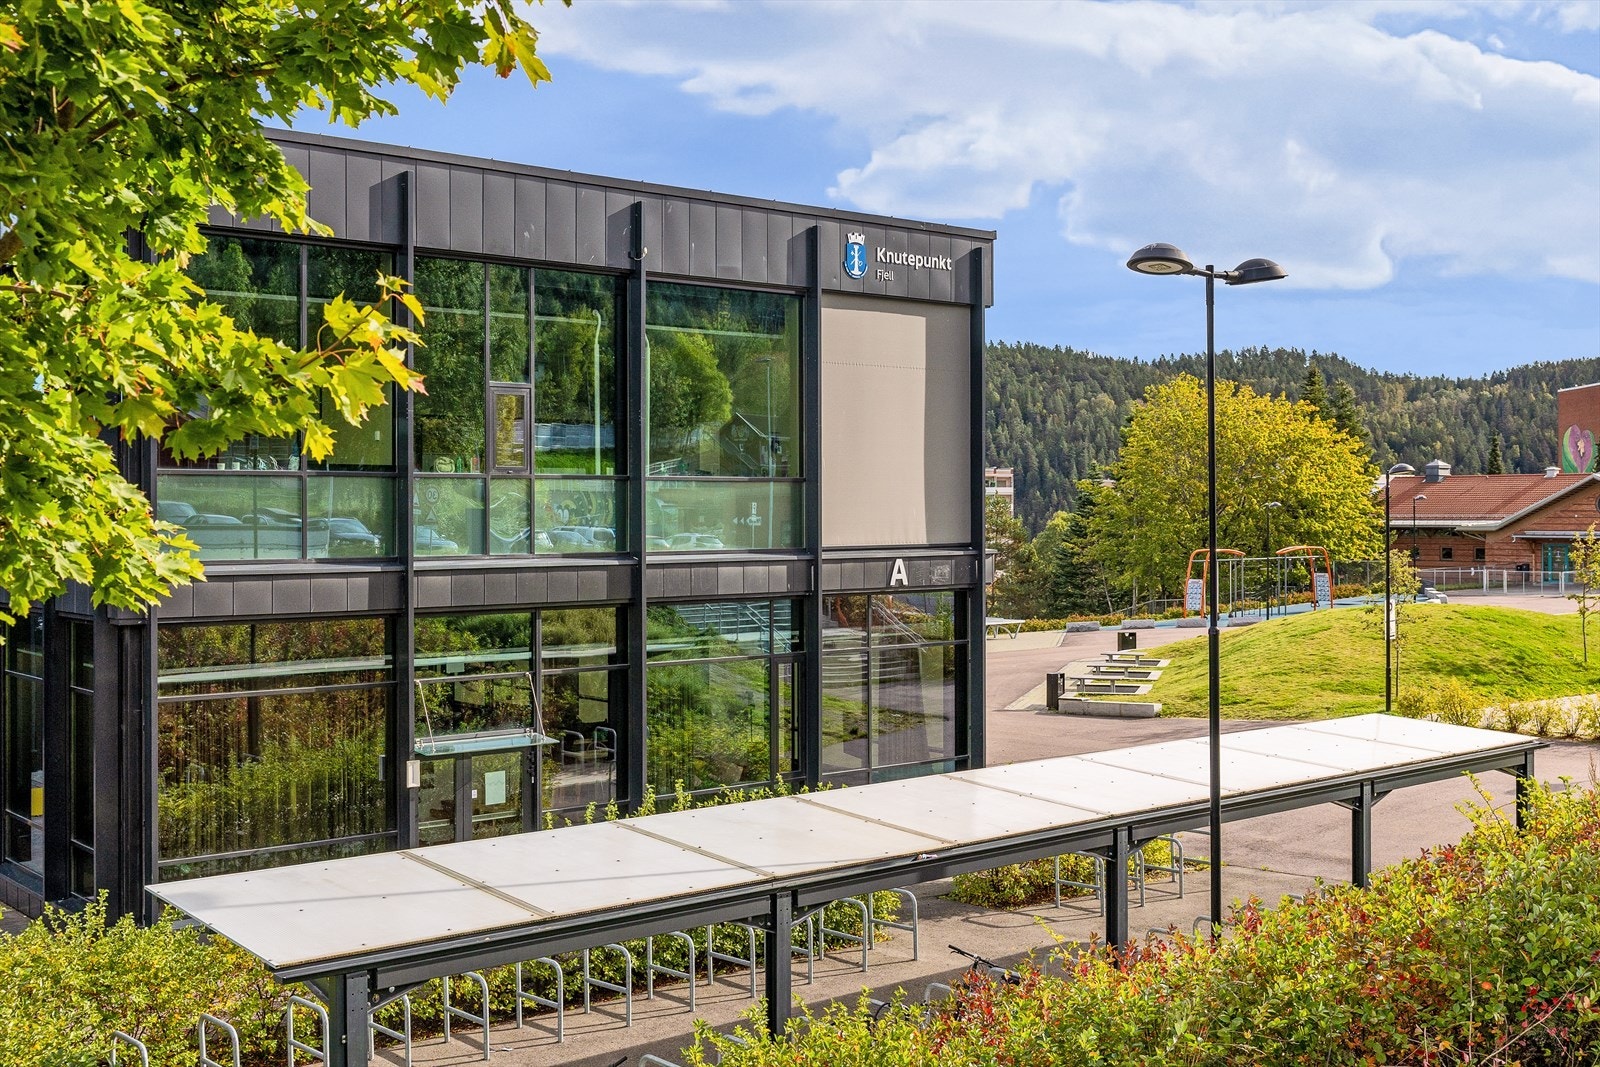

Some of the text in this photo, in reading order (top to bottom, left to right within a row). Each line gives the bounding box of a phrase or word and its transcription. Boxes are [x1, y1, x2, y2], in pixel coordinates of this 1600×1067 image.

[877, 247, 952, 270] Knutepunkt
[877, 270, 894, 281] Fjell
[890, 558, 908, 586] A
